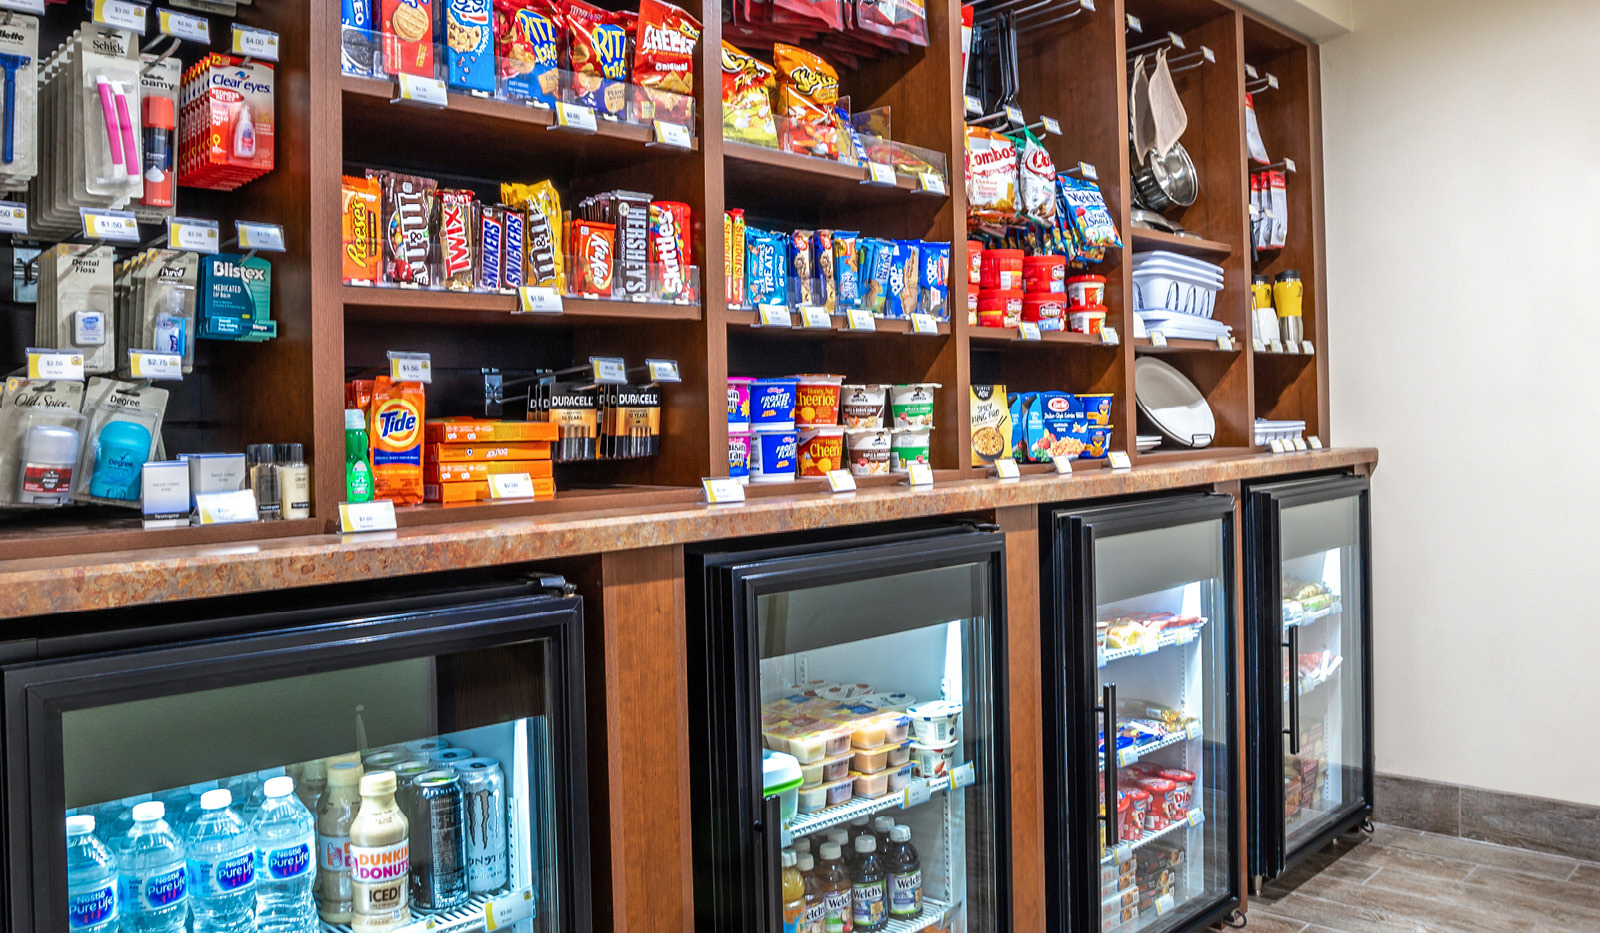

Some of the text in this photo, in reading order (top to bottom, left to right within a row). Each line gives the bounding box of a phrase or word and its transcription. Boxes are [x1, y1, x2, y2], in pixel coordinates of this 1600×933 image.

[516, 12, 557, 45] RITZ
[93, 39, 125, 54] Schick
[246, 37, 264, 46] $4.00
[212, 55, 222, 65] 12
[141, 79, 174, 92] oamy
[212, 73, 270, 95] Clear eyes
[101, 221, 122, 229] $1.50
[347, 200, 367, 268] Reese's
[444, 207, 470, 279] TWIX
[626, 207, 647, 293] HERSHEY'S
[483, 220, 500, 290] SNICKERS
[507, 213, 523, 288] SNICKERS
[72, 258, 101, 267] Dental
[764, 245, 775, 294] TREATS
[76, 267, 96, 275] Floss
[213, 260, 268, 284] Blistex
[213, 284, 242, 294] MEDICATED
[148, 358, 167, 367] $2.75
[14, 393, 37, 407] Old
[110, 395, 141, 407] Degree
[552, 395, 593, 406] DURACELL
[619, 394, 658, 405] DURACELL
[761, 393, 791, 405] FROSTED
[796, 391, 836, 407] Cheerios
[569, 414, 583, 422] YEARS
[636, 411, 649, 419] YEARS
[380, 410, 417, 438] Tide
[108, 458, 134, 469] Degree
[270, 851, 309, 868] Pure Life
[218, 860, 255, 880] Pure Life
[359, 859, 409, 880] DONUTS
[147, 876, 186, 897] Pure Life
[853, 886, 882, 899] Welch's
[70, 895, 113, 915] Pure Life
